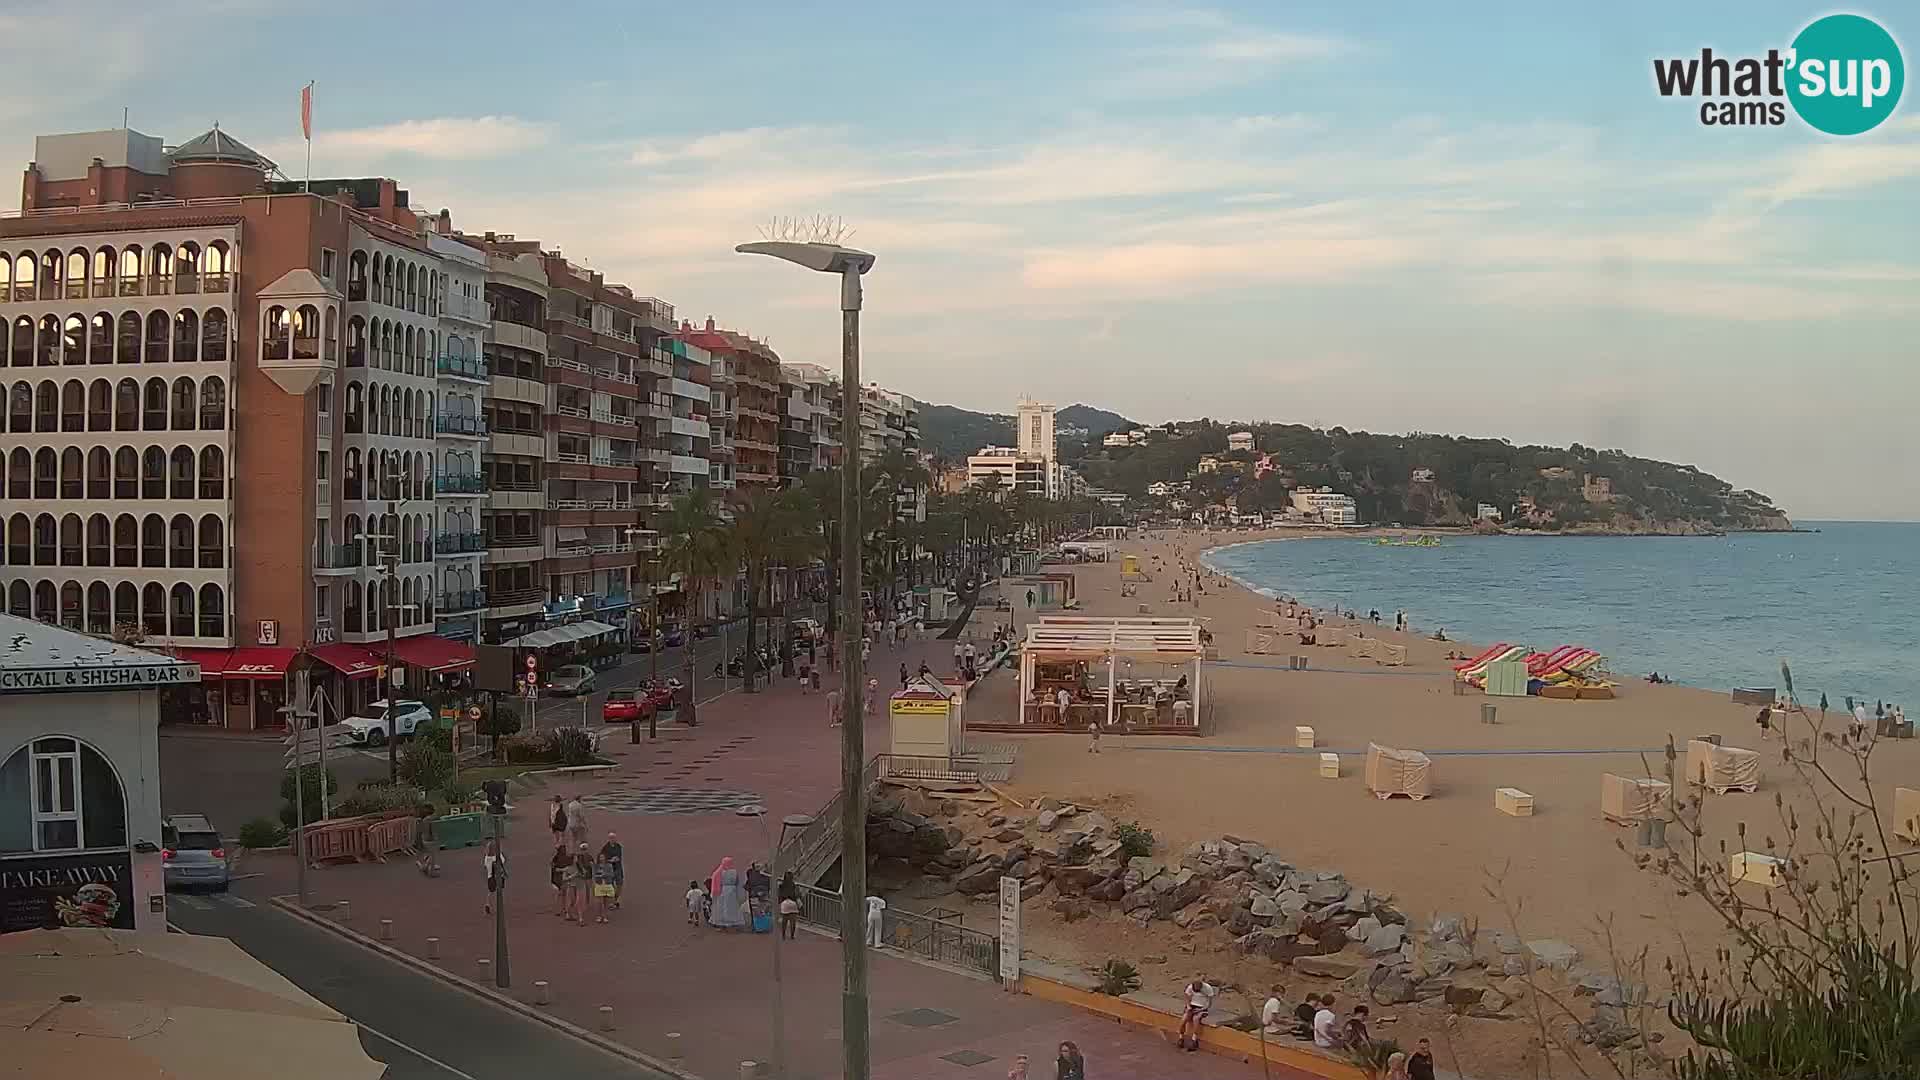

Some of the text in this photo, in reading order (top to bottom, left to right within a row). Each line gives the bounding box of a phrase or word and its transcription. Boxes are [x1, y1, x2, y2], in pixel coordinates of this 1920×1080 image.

[315, 627, 334, 644] KFC
[65, 672, 76, 685] &
[82, 668, 143, 685] SHISHA
[147, 667, 180, 682] BAR
